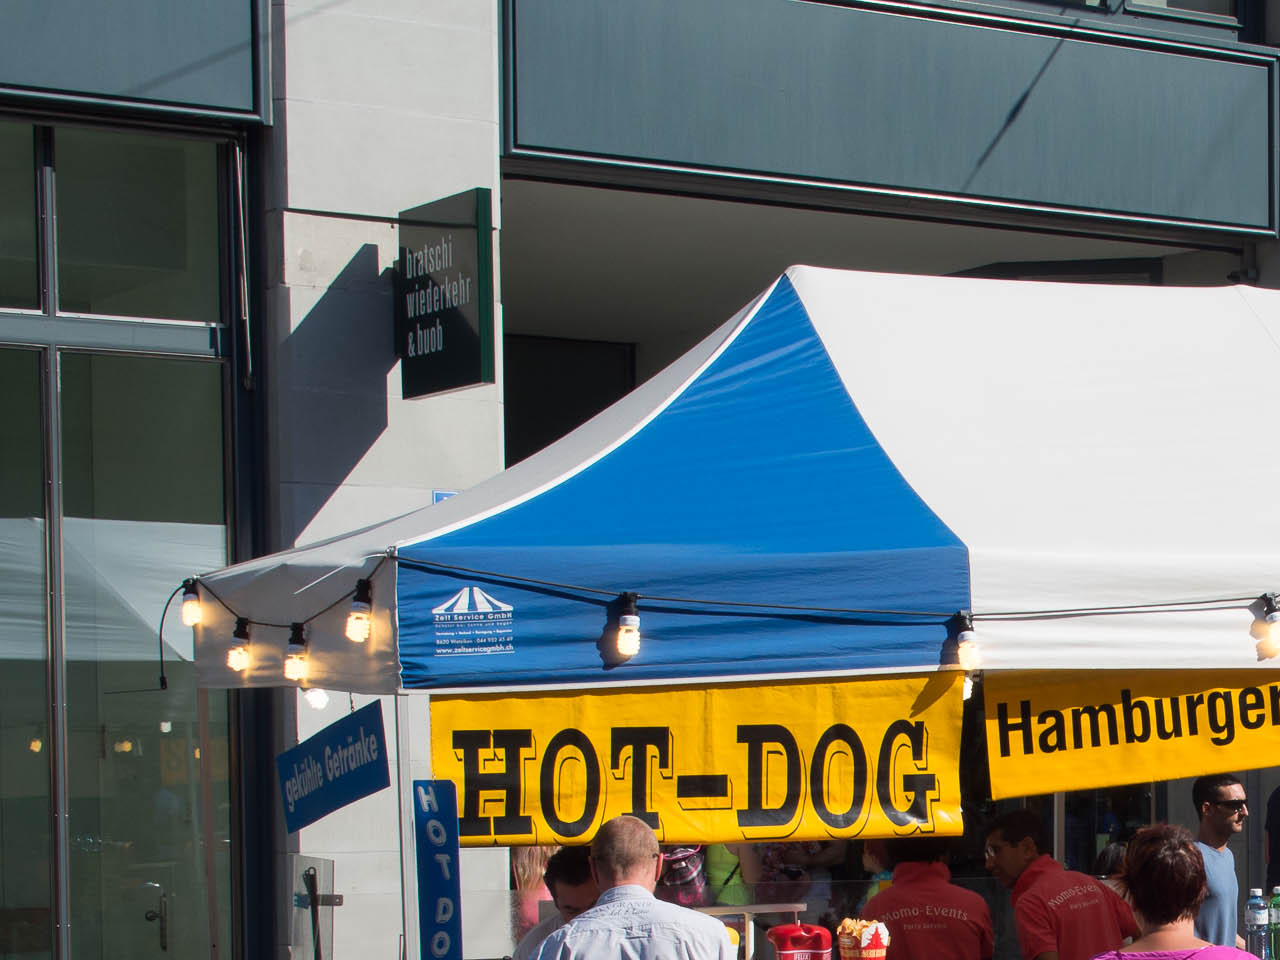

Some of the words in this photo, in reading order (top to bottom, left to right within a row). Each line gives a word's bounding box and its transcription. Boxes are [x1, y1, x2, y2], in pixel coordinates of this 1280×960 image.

[406, 234, 453, 280] bratschi
[406, 272, 472, 319] wiederkehr
[408, 331, 415, 358] &
[417, 318, 443, 356] buob
[487, 612, 513, 620] GmbH
[285, 753, 323, 813] gekühlte
[324, 727, 378, 783] Getränke
[452, 719, 938, 838] HOT-DOG
[417, 785, 451, 881] HOT
